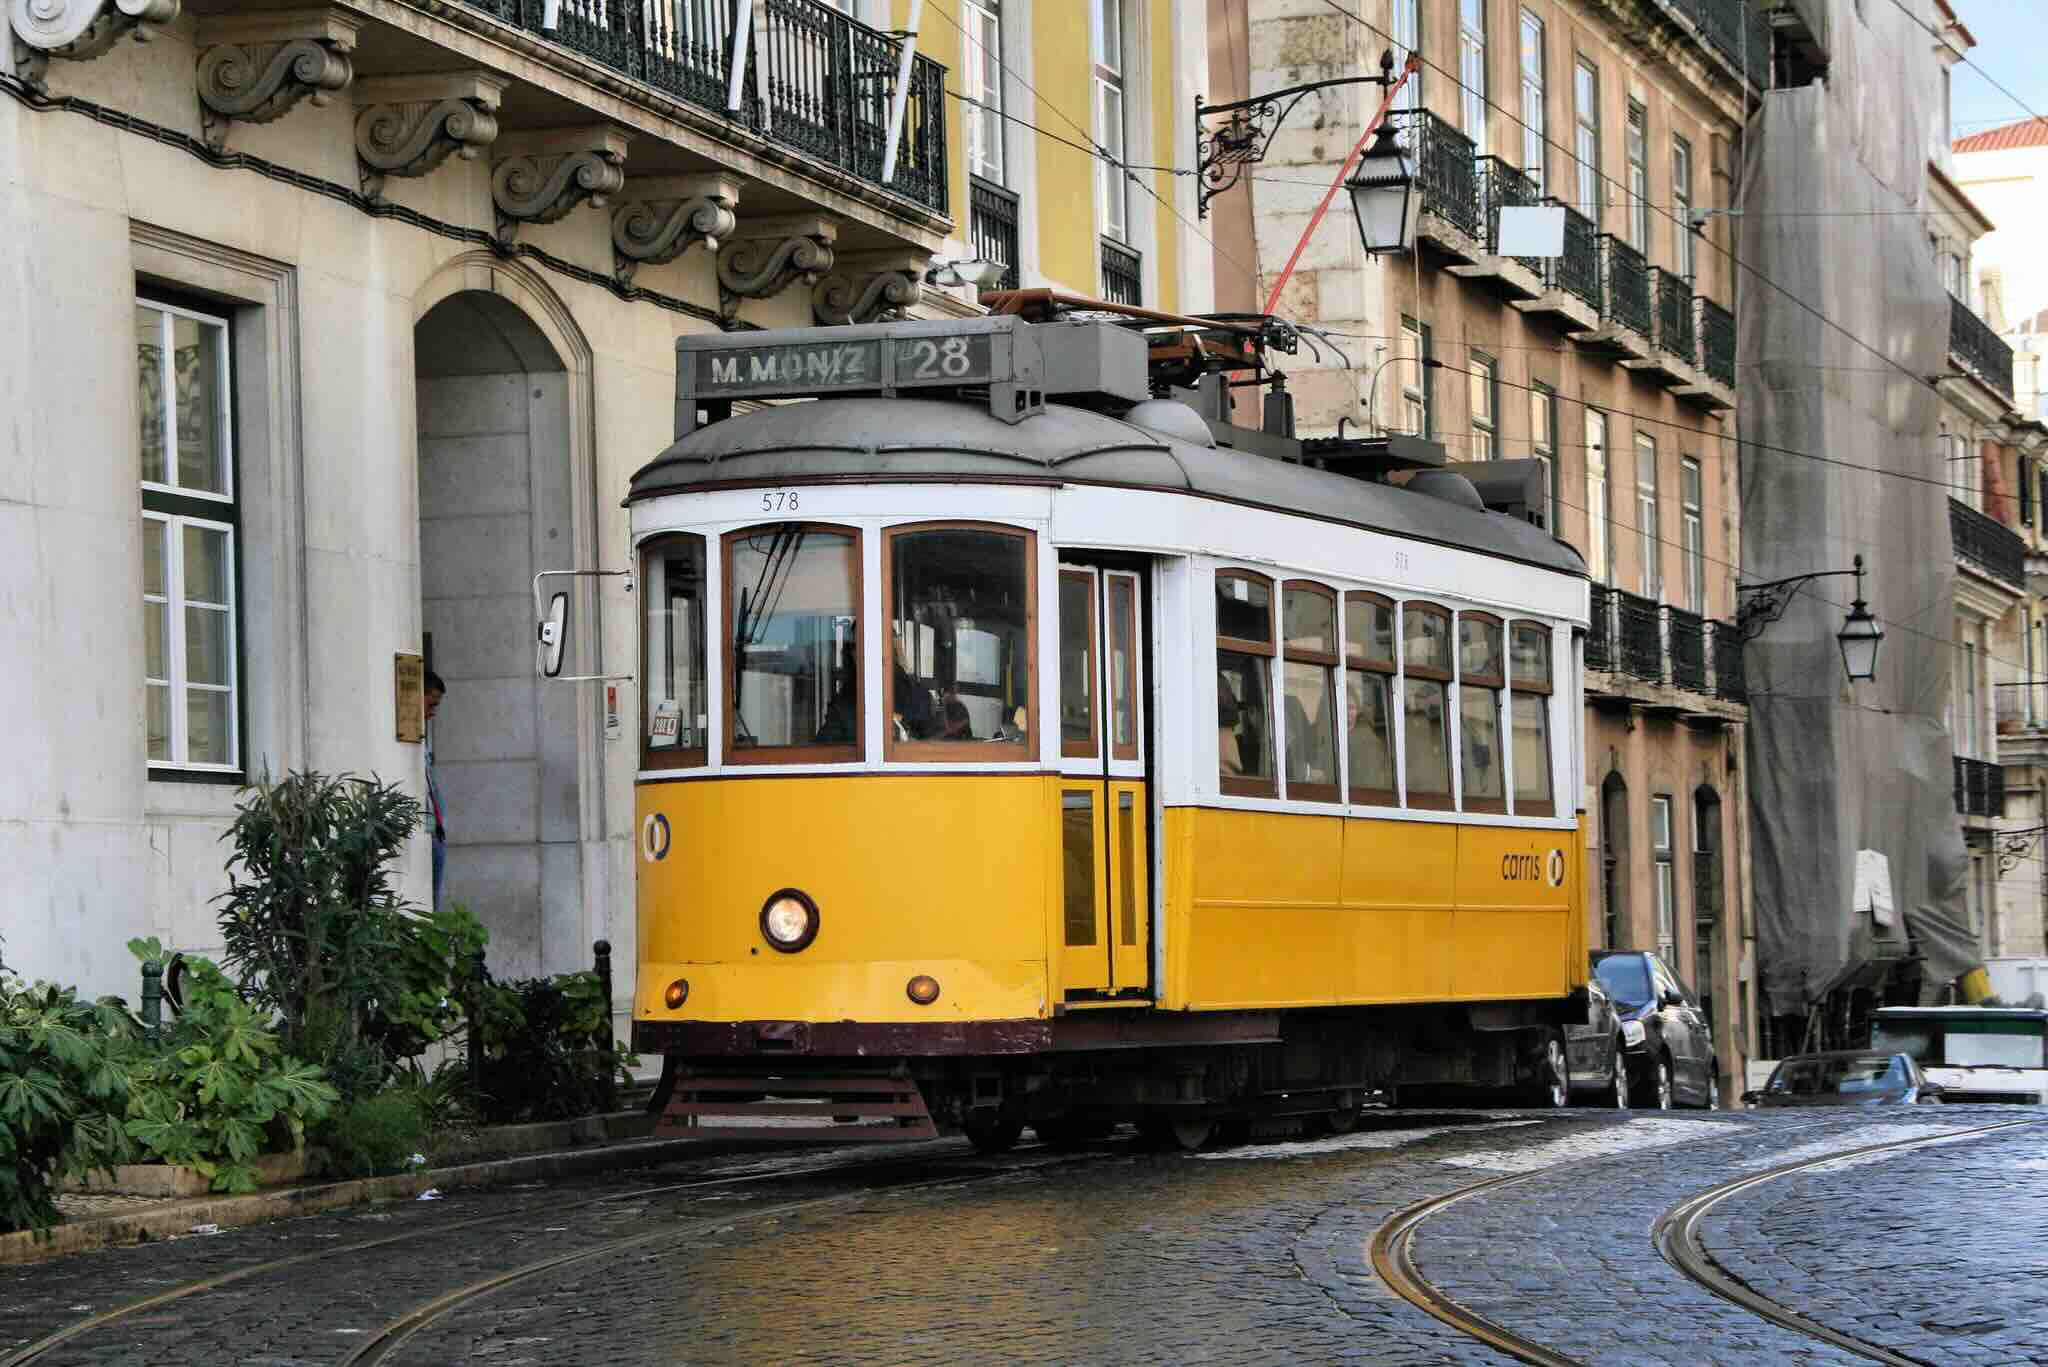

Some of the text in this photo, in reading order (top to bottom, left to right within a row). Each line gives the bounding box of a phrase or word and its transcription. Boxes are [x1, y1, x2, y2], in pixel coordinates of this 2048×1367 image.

[914, 337, 970, 379] 28
[762, 492, 799, 511] 578
[1502, 843, 1540, 881] carris
